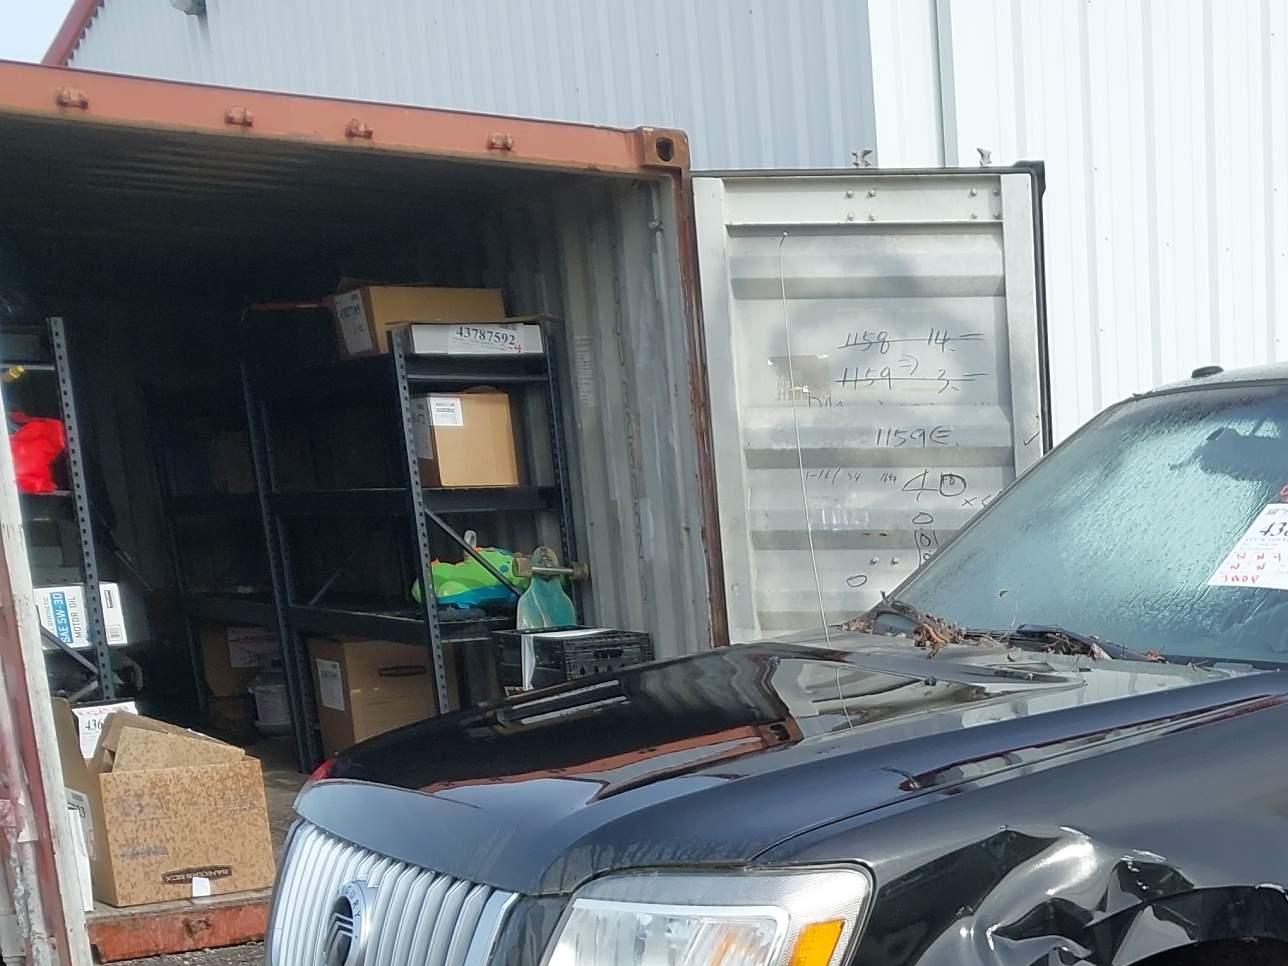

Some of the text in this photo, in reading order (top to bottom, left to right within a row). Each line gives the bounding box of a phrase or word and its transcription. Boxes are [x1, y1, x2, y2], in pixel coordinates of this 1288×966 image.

[456, 326, 515, 345] 43787592
[52, 592, 70, 643] SAE 5W-30
[67, 596, 82, 639] MOTOR OIL
